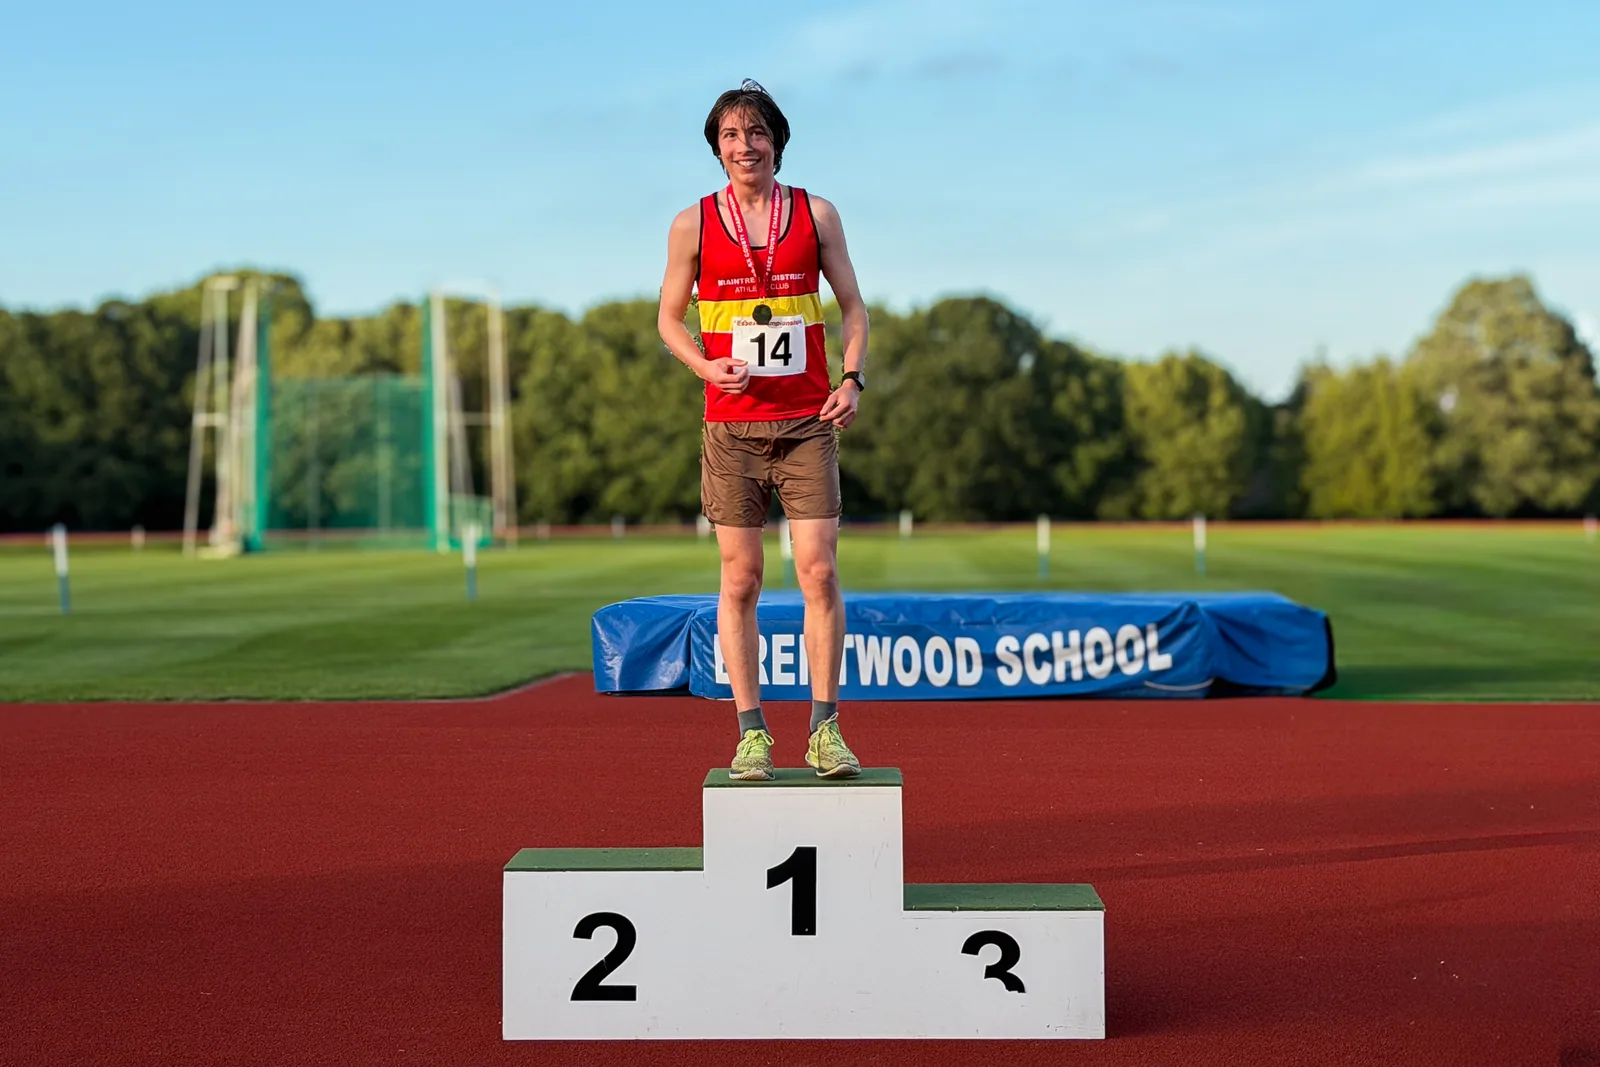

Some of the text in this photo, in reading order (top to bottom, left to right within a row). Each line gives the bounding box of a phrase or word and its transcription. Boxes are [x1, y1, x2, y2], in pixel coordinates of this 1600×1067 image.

[718, 277, 756, 286] BRAINTRE
[750, 332, 792, 367] 14
[996, 624, 1173, 687] SCHOOL
[766, 846, 817, 936] 1
[570, 911, 637, 1001] 2
